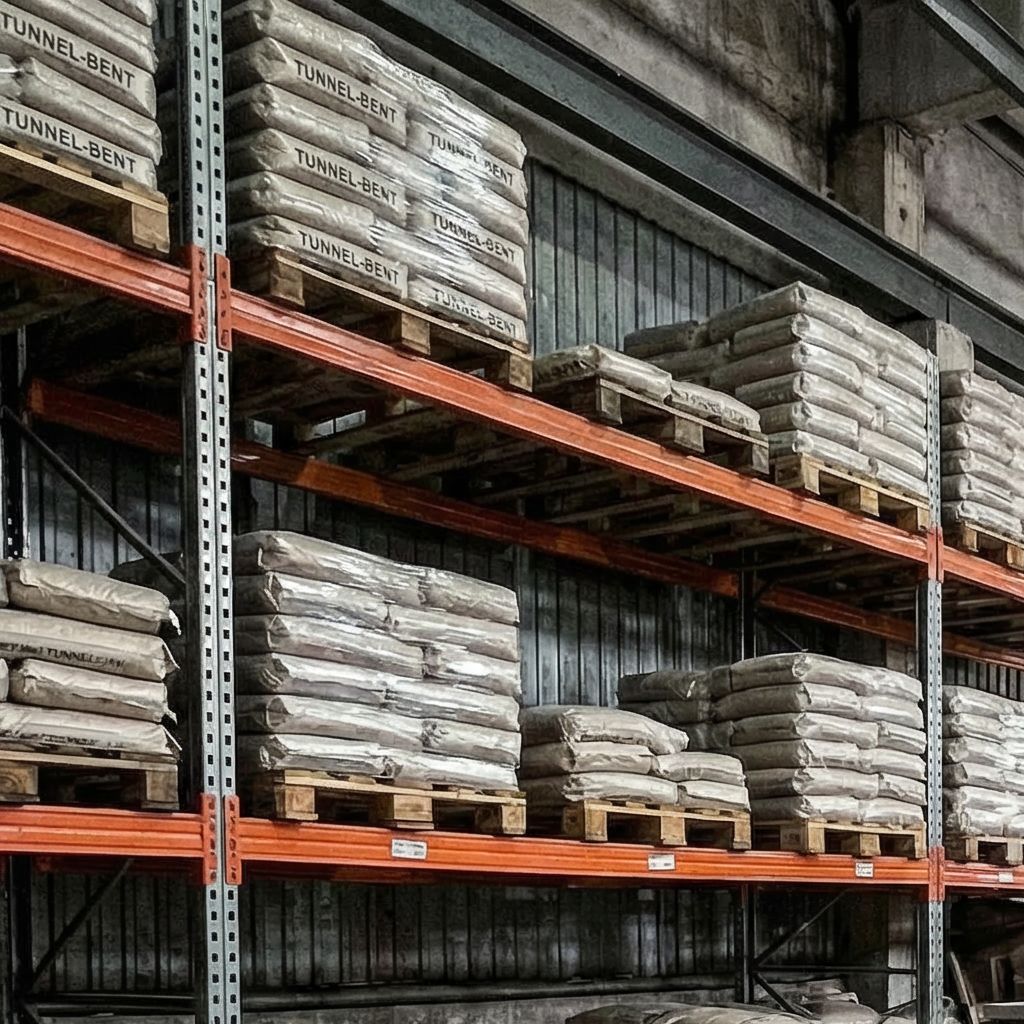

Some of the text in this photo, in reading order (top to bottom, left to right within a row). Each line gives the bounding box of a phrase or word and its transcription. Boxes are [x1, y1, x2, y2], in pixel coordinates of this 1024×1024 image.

[1, 13, 135, 88] TUNNEL-BENT
[294, 59, 397, 122] TUNNEL-BENT
[2, 107, 136, 173] TUNNEL-BENT
[295, 147, 397, 205] TUNNEL-BENT
[298, 230, 399, 284] TUNNEL-BENT
[432, 288, 516, 339] TUNNELBENT
